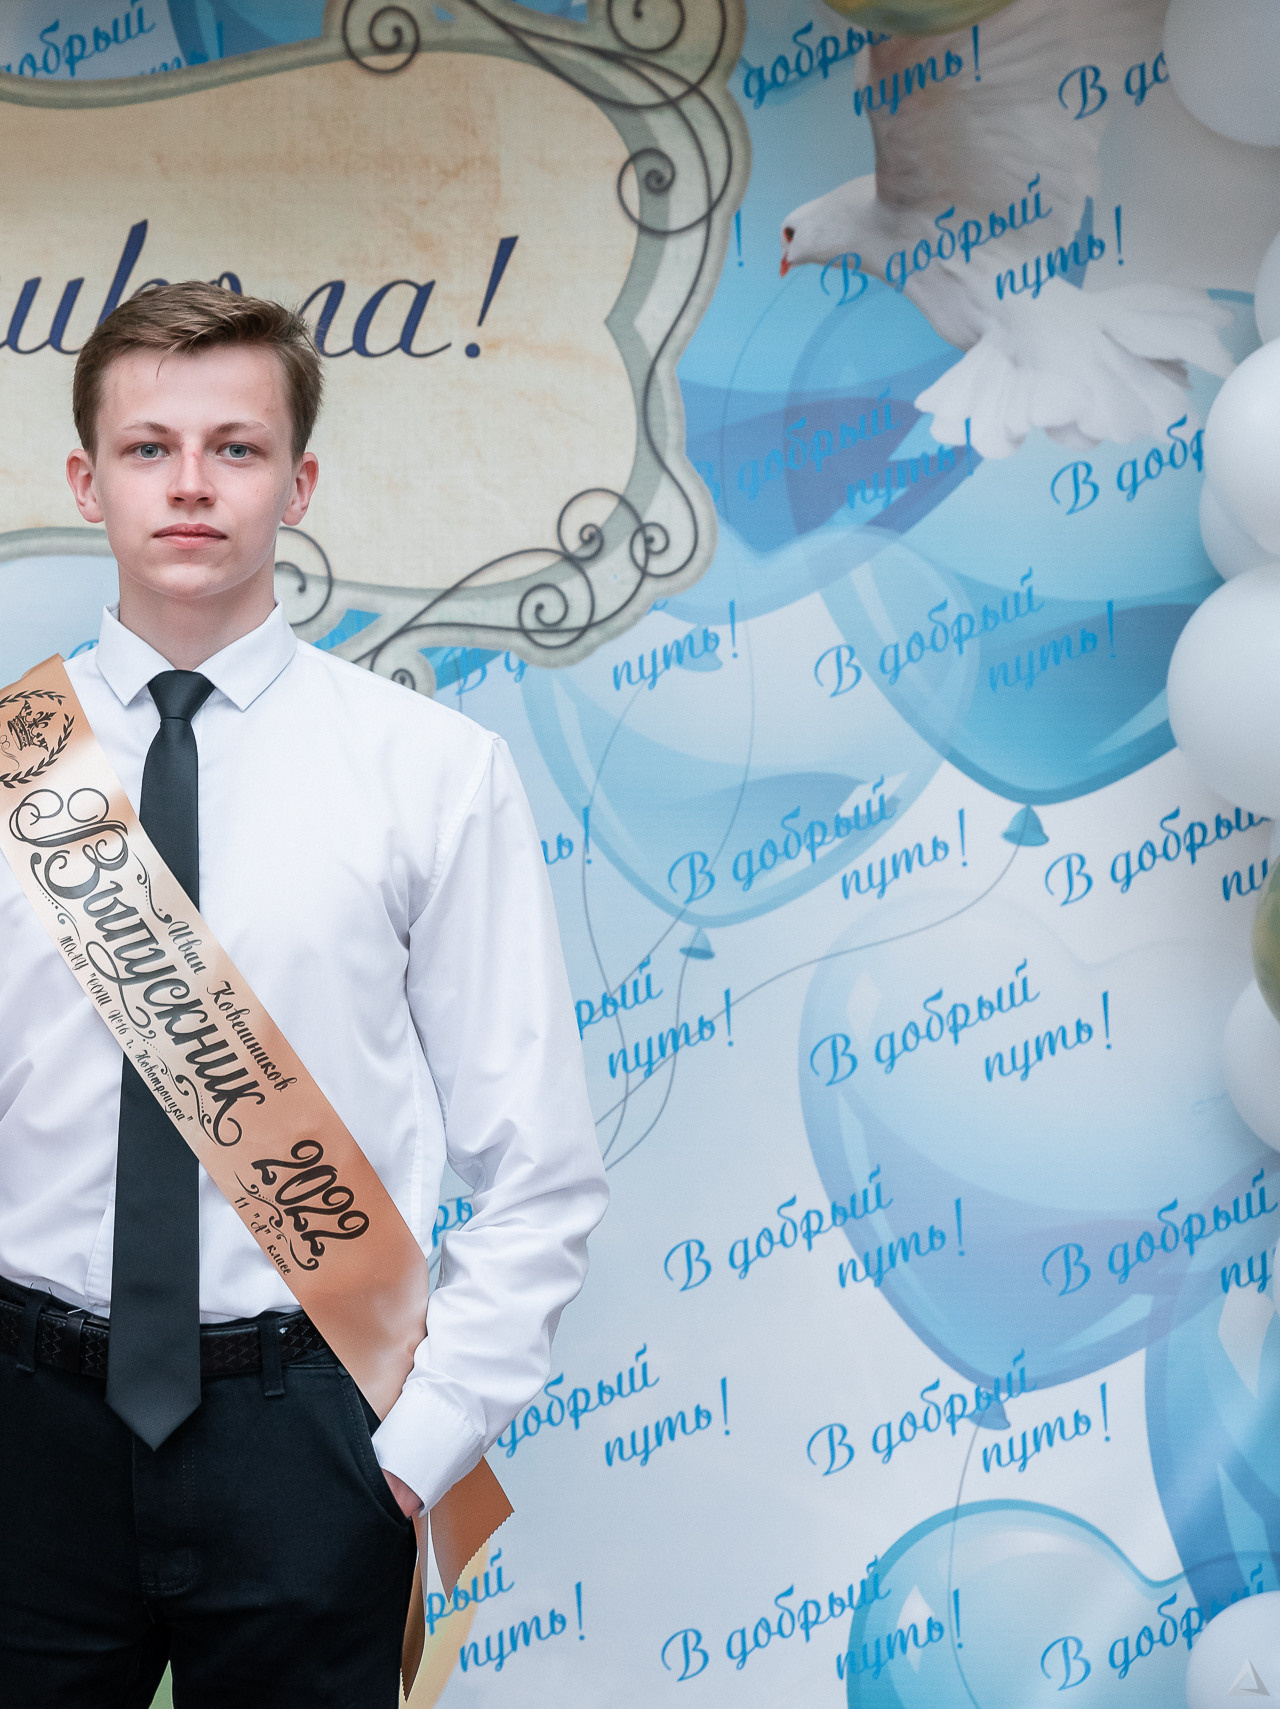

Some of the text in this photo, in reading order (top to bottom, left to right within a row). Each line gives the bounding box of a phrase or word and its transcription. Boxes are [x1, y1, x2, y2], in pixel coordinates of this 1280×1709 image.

[0, 0, 155, 77] обрый
[743, 20, 892, 110] добры
[853, 25, 981, 116] путь!
[820, 173, 1053, 307] В добрый
[995, 205, 1125, 300] путь!
[737, 387, 901, 500] добрый
[846, 417, 975, 509] путь!
[1051, 414, 1204, 515] В добр
[612, 599, 739, 690] путь!
[814, 567, 1045, 697] В добрый
[988, 600, 1117, 692] путь!
[668, 775, 900, 904] В добрый
[841, 808, 968, 900] путь!
[1045, 853, 1093, 906] В
[1110, 807, 1271, 893] добры
[9, 788, 265, 1147] Выпускник
[168, 921, 297, 1092] Иван Ковешников
[608, 988, 735, 1079] путь!
[810, 958, 1040, 1086] В добрый
[985, 991, 1112, 1082] путь!
[234, 1197, 250, 1210] 11
[267, 1244, 291, 1275] класс
[251, 1139, 369, 1257] 2022
[664, 1165, 893, 1292] В добрый
[838, 1197, 965, 1288] путь!
[1042, 1243, 1091, 1297] В
[1108, 1168, 1278, 1284] добрый
[605, 1377, 731, 1467] путь!
[806, 1349, 1037, 1476] В добрый
[982, 1382, 1110, 1472] путь!
[459, 1582, 586, 1672] путь!
[661, 1556, 890, 1681] В добрый
[836, 1589, 964, 1679] путь!
[1040, 1636, 1091, 1690] В
